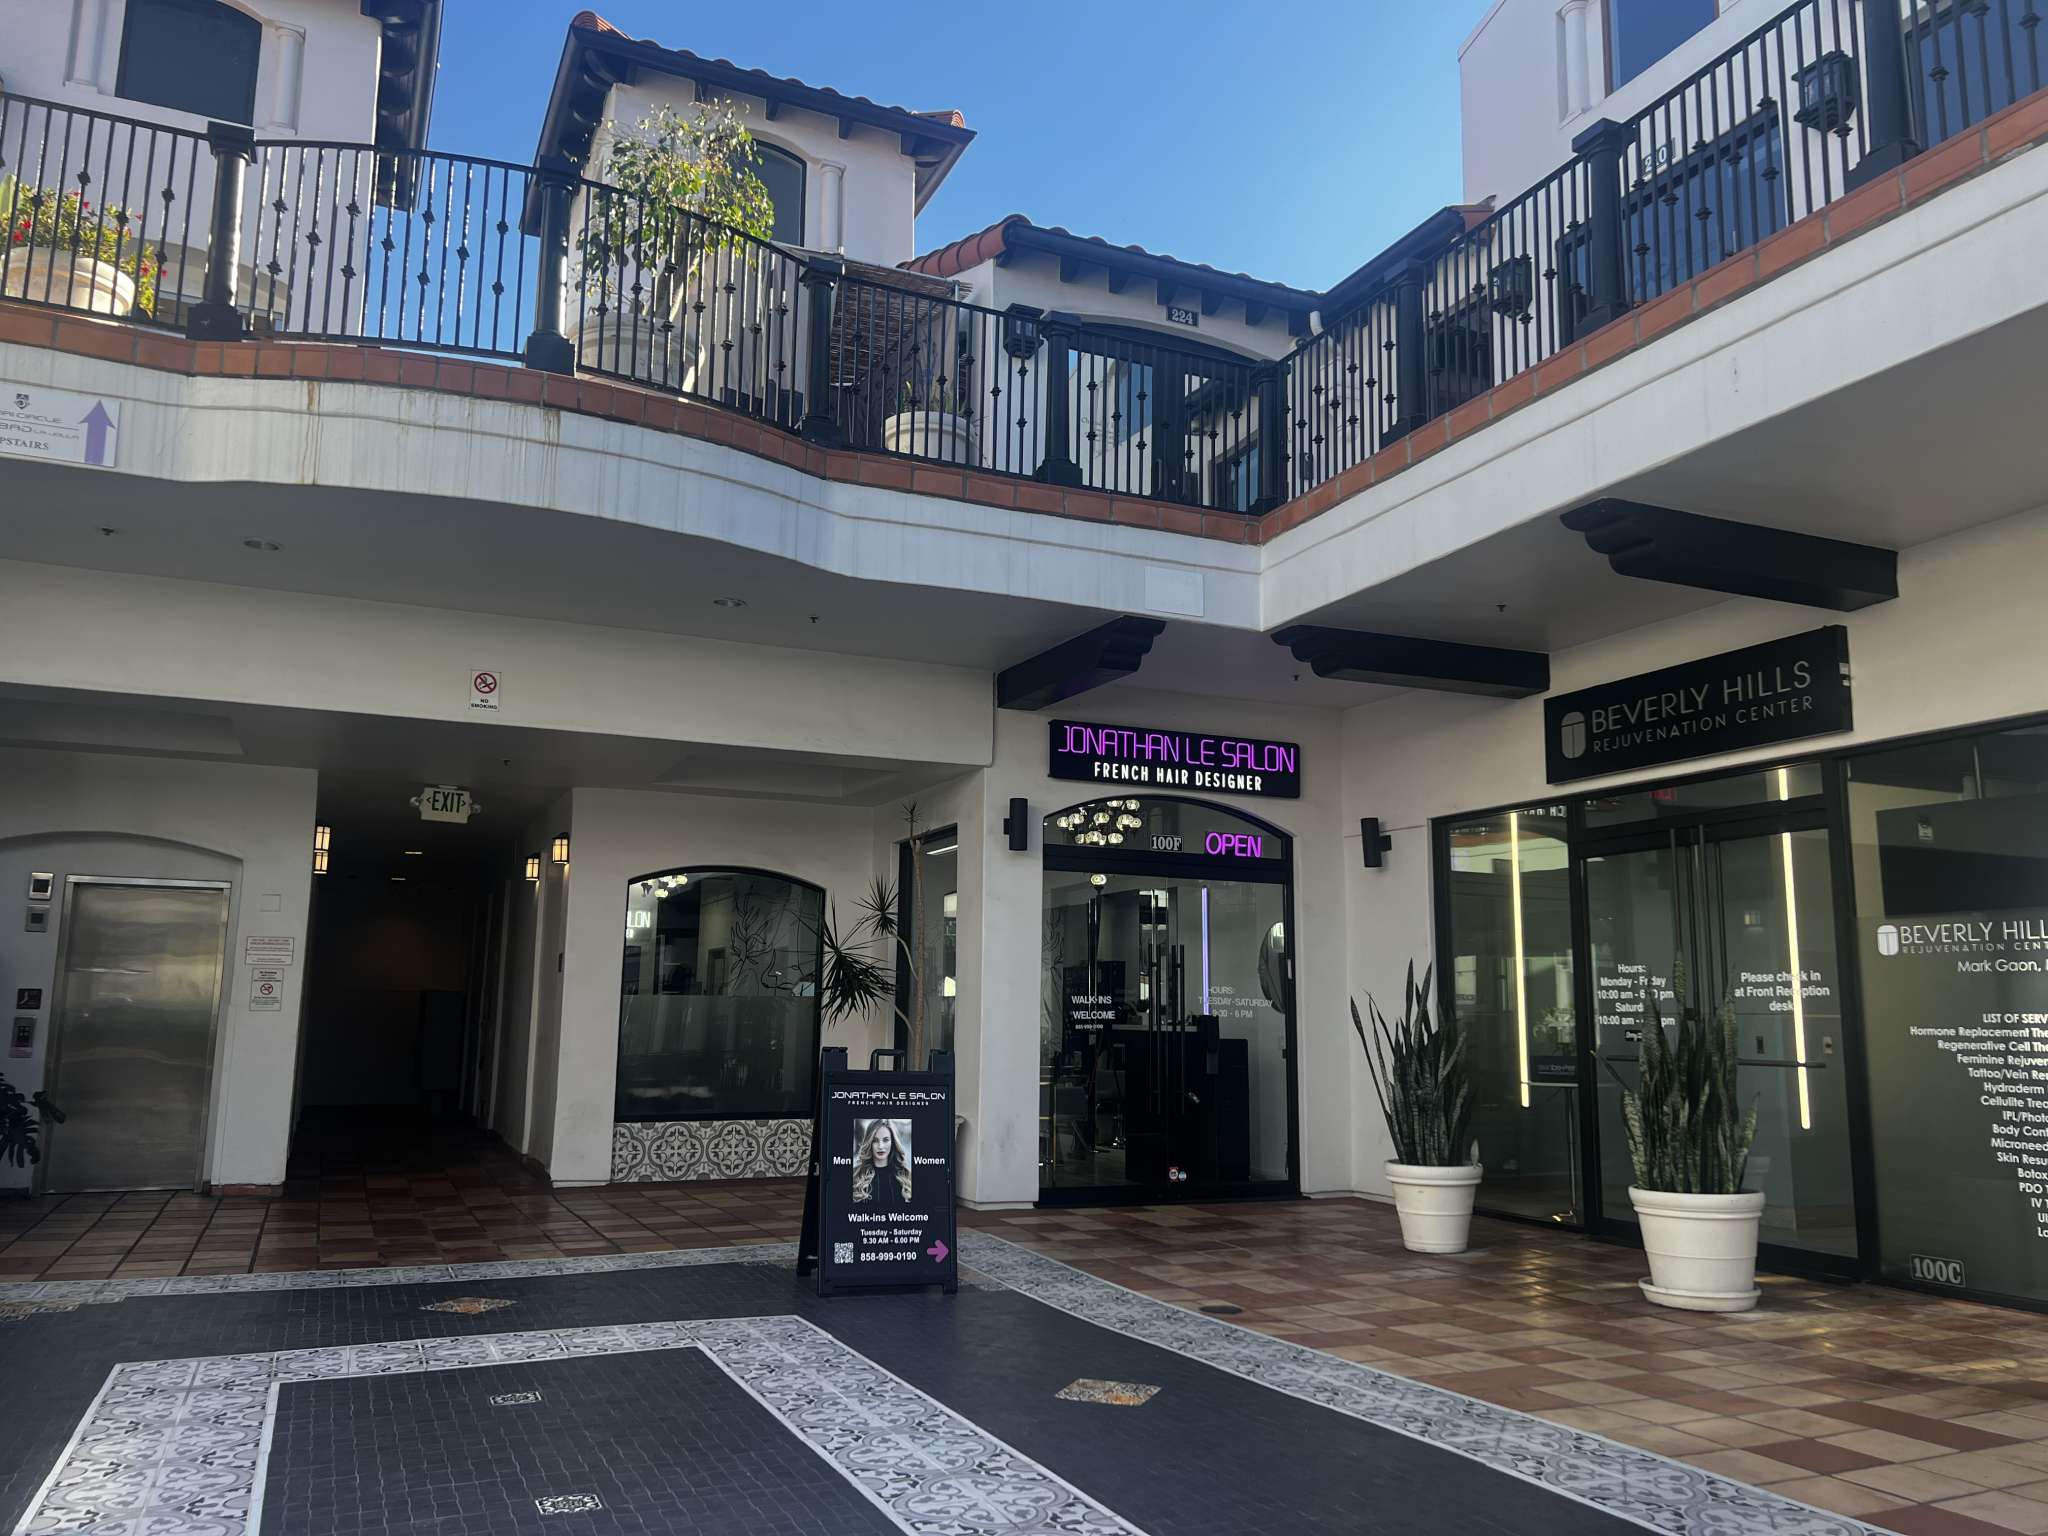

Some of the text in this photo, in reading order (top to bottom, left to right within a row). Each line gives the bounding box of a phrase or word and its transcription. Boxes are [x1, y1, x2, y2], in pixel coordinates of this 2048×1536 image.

[1172, 309, 1193, 324] 224
[1592, 661, 1811, 733] BEVERLY HILLS
[1594, 695, 1813, 752] REJUVENATION CENTER
[1058, 725, 1294, 773] JONATHAN LE SALON
[1094, 762, 1262, 791] FRENCH HAIR DESIGNER
[432, 790, 463, 813] EXIT
[1152, 836, 1181, 851] 100F
[1206, 832, 1262, 858] OPEN
[1900, 921, 1993, 944] BEVERLY
[1903, 943, 2005, 954] REJUVENATION
[1957, 960, 1993, 973] Mark
[1995, 958, 2042, 973] Gaon,
[1600, 977, 1633, 988] Monday
[1640, 976, 1667, 988] Frday
[1741, 970, 1821, 983] Please chk in
[1598, 989, 1619, 999] 10:00
[1620, 990, 1633, 999] am
[1660, 990, 1674, 1001] pm
[1734, 985, 1830, 998] at Front Reption
[1071, 995, 1112, 1004] WALK-INS
[1198, 996, 1273, 1007] TESDAY-SATURDAY
[1615, 1002, 1644, 1013] Saturd
[1072, 1010, 1116, 1020] WELCOME
[1599, 1015, 1620, 1025] 10:00
[1621, 1017, 1635, 1025] am
[1982, 1013, 2001, 1023] LIST
[2004, 1013, 2019, 1023] OF
[1661, 1017, 1675, 1028] pm
[1909, 1026, 1956, 1036] Hormone
[1958, 1026, 2030, 1038] Replacement
[1937, 1040, 2007, 1052] Regenerative
[2008, 1041, 2031, 1052] Cell
[1957, 1053, 2005, 1065] Feminine
[1968, 1067, 2029, 1080] Tattoo/Vein
[1983, 1082, 2045, 1094] Hydraderm
[831, 1091, 945, 1100] JONATHAN LE SALON
[1980, 1095, 2025, 1107] Cellulite
[1992, 1123, 2020, 1137] Body
[833, 1156, 945, 1165] Men Women
[1997, 1152, 2019, 1164] Skin
[2019, 1182, 2043, 1194] PDO
[848, 1213, 929, 1222] Walk-ins Welcome
[860, 1229, 888, 1237] Tuesday
[893, 1228, 922, 1237] Saturday
[909, 1236, 920, 1244] PM
[860, 1251, 917, 1261] 858-999-0190
[1913, 1257, 1961, 1284] 100C
